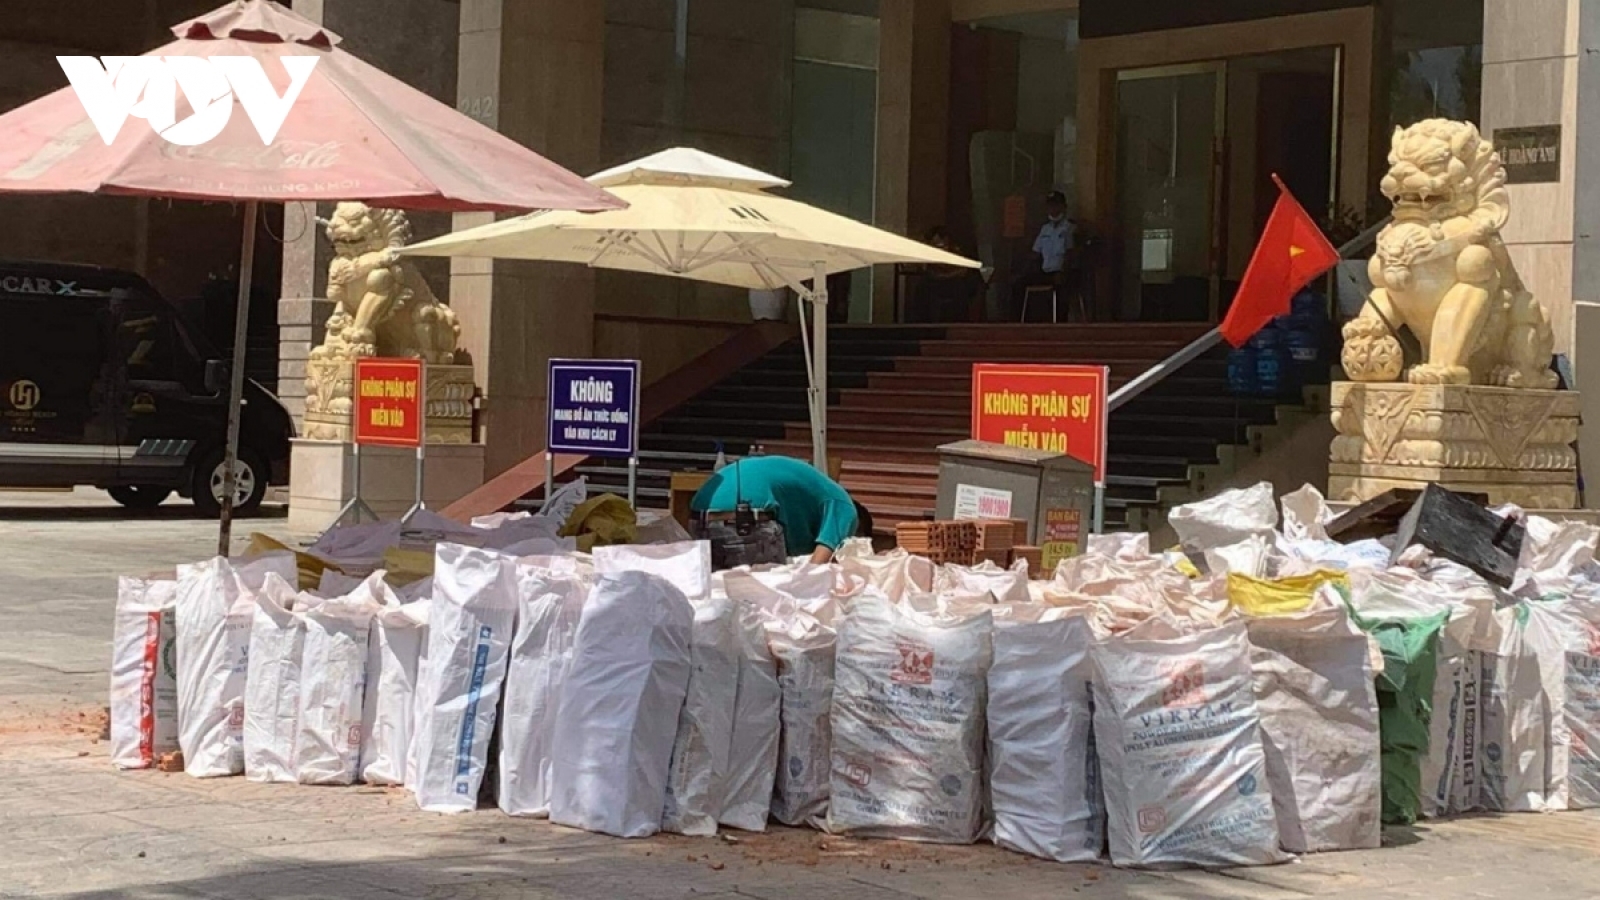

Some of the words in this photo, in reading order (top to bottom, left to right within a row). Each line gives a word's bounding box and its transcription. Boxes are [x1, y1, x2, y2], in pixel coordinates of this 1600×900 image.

[361, 376, 384, 397] KHÔNG
[385, 376, 405, 402] PHẬN
[406, 380, 417, 402] SỰ
[570, 376, 613, 404] KHÔNG
[371, 403, 389, 427] MIỄN
[390, 405, 405, 428] VÀO
[554, 408, 573, 421] MANG
[983, 388, 1029, 416] KHÔNG
[1031, 390, 1068, 422] PHẬN
[1071, 393, 1092, 423] SỰ
[563, 425, 577, 439] VÀO
[578, 427, 590, 440] KHU
[591, 427, 608, 441] CÁCH
[609, 430, 617, 441] LY
[1003, 423, 1038, 449] MIỄN
[1041, 427, 1068, 453] VÀO
[1140, 701, 1234, 728] VIKRAM
